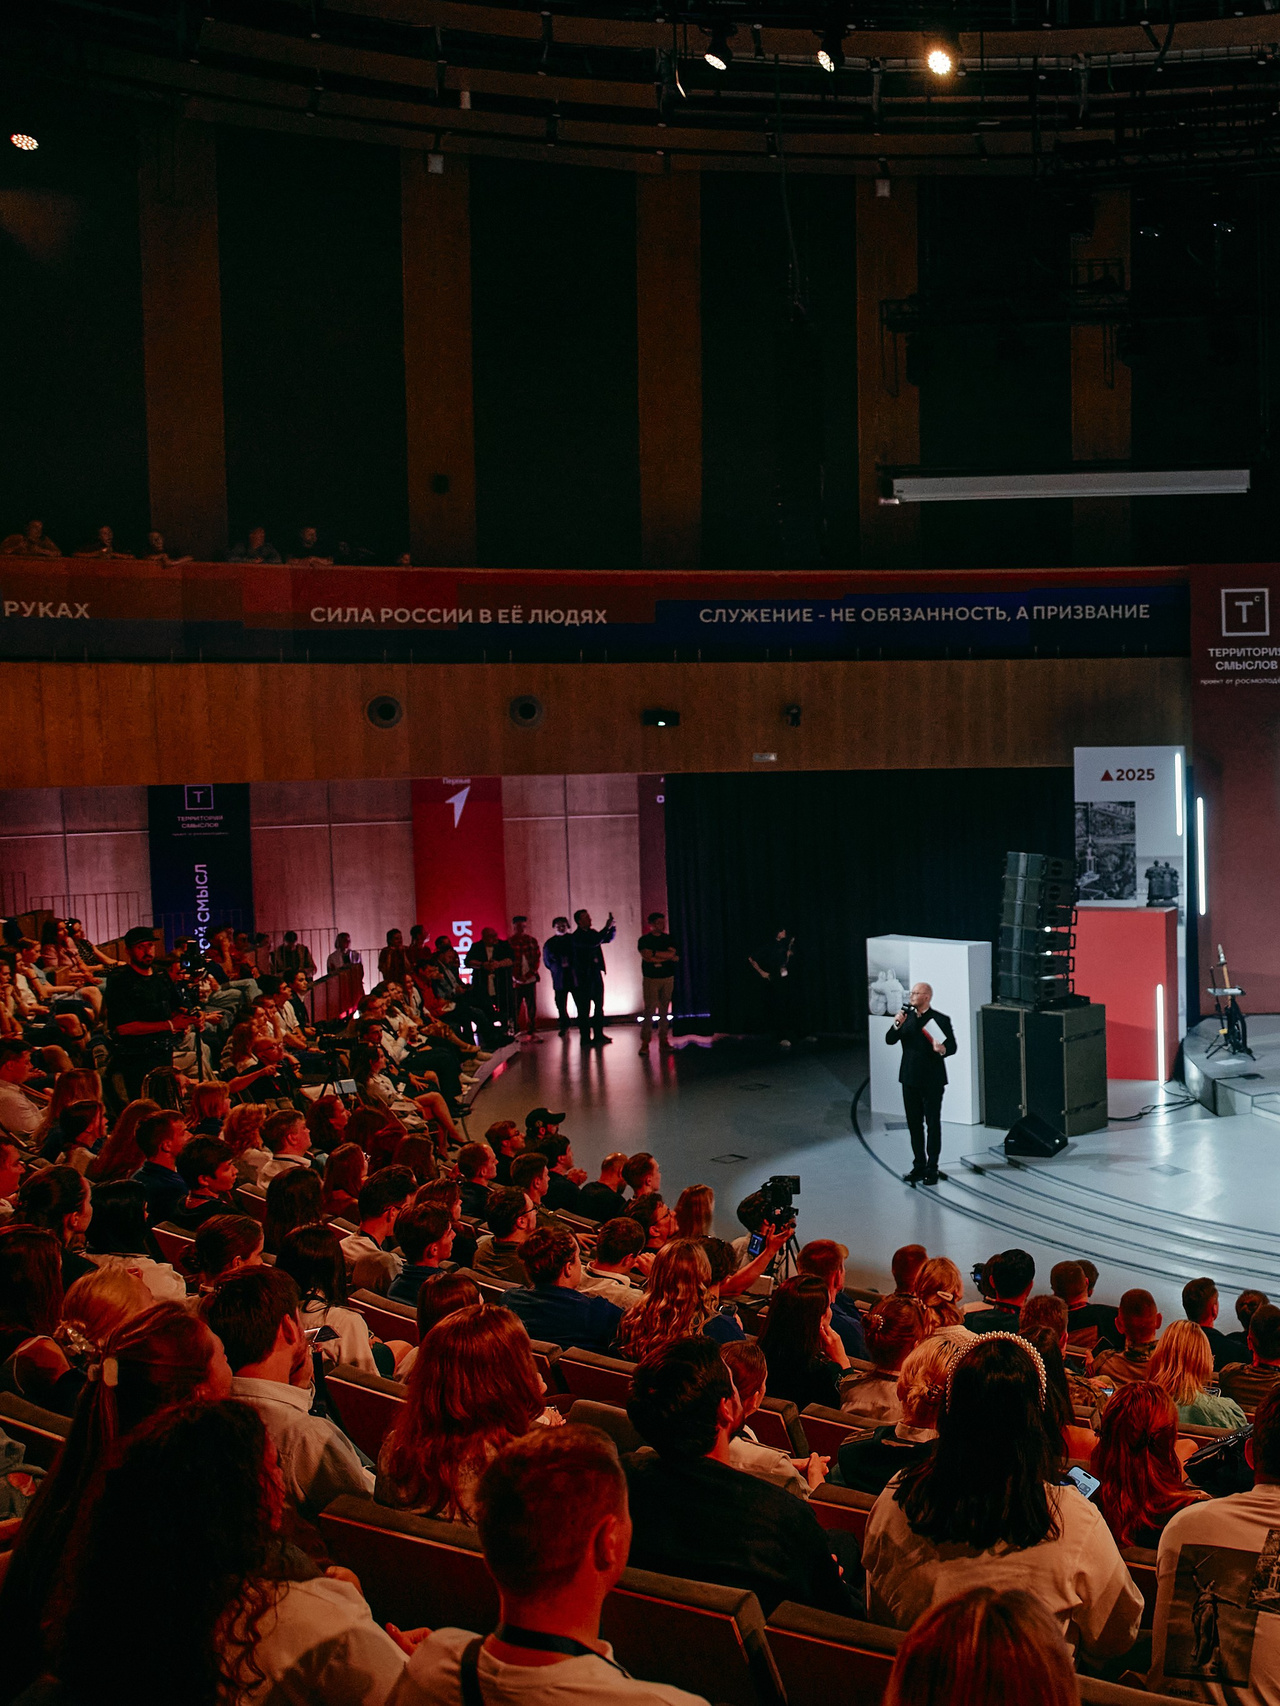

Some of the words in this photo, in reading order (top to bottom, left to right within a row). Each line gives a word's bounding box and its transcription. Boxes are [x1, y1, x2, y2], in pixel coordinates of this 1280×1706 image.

[3, 600, 91, 619] РУКАХ
[310, 606, 375, 623] СИЛА
[380, 607, 473, 624] РОССИИ
[480, 609, 492, 624] В
[498, 605, 523, 624] ЕЁ
[528, 608, 607, 627] ЛЮДЯХ
[699, 607, 814, 623] СЛУЖЕНИЕ
[831, 607, 857, 622] НЕ
[860, 606, 1011, 623] ОБЯЗАННОСТЬ,
[1015, 606, 1029, 621] А
[1032, 604, 1151, 620] ПРИЗВАНИЕ
[1215, 660, 1278, 671] СМЫСЛОВ
[1116, 768, 1155, 781] 2025
[194, 863, 210, 923] СМЫСЛ
